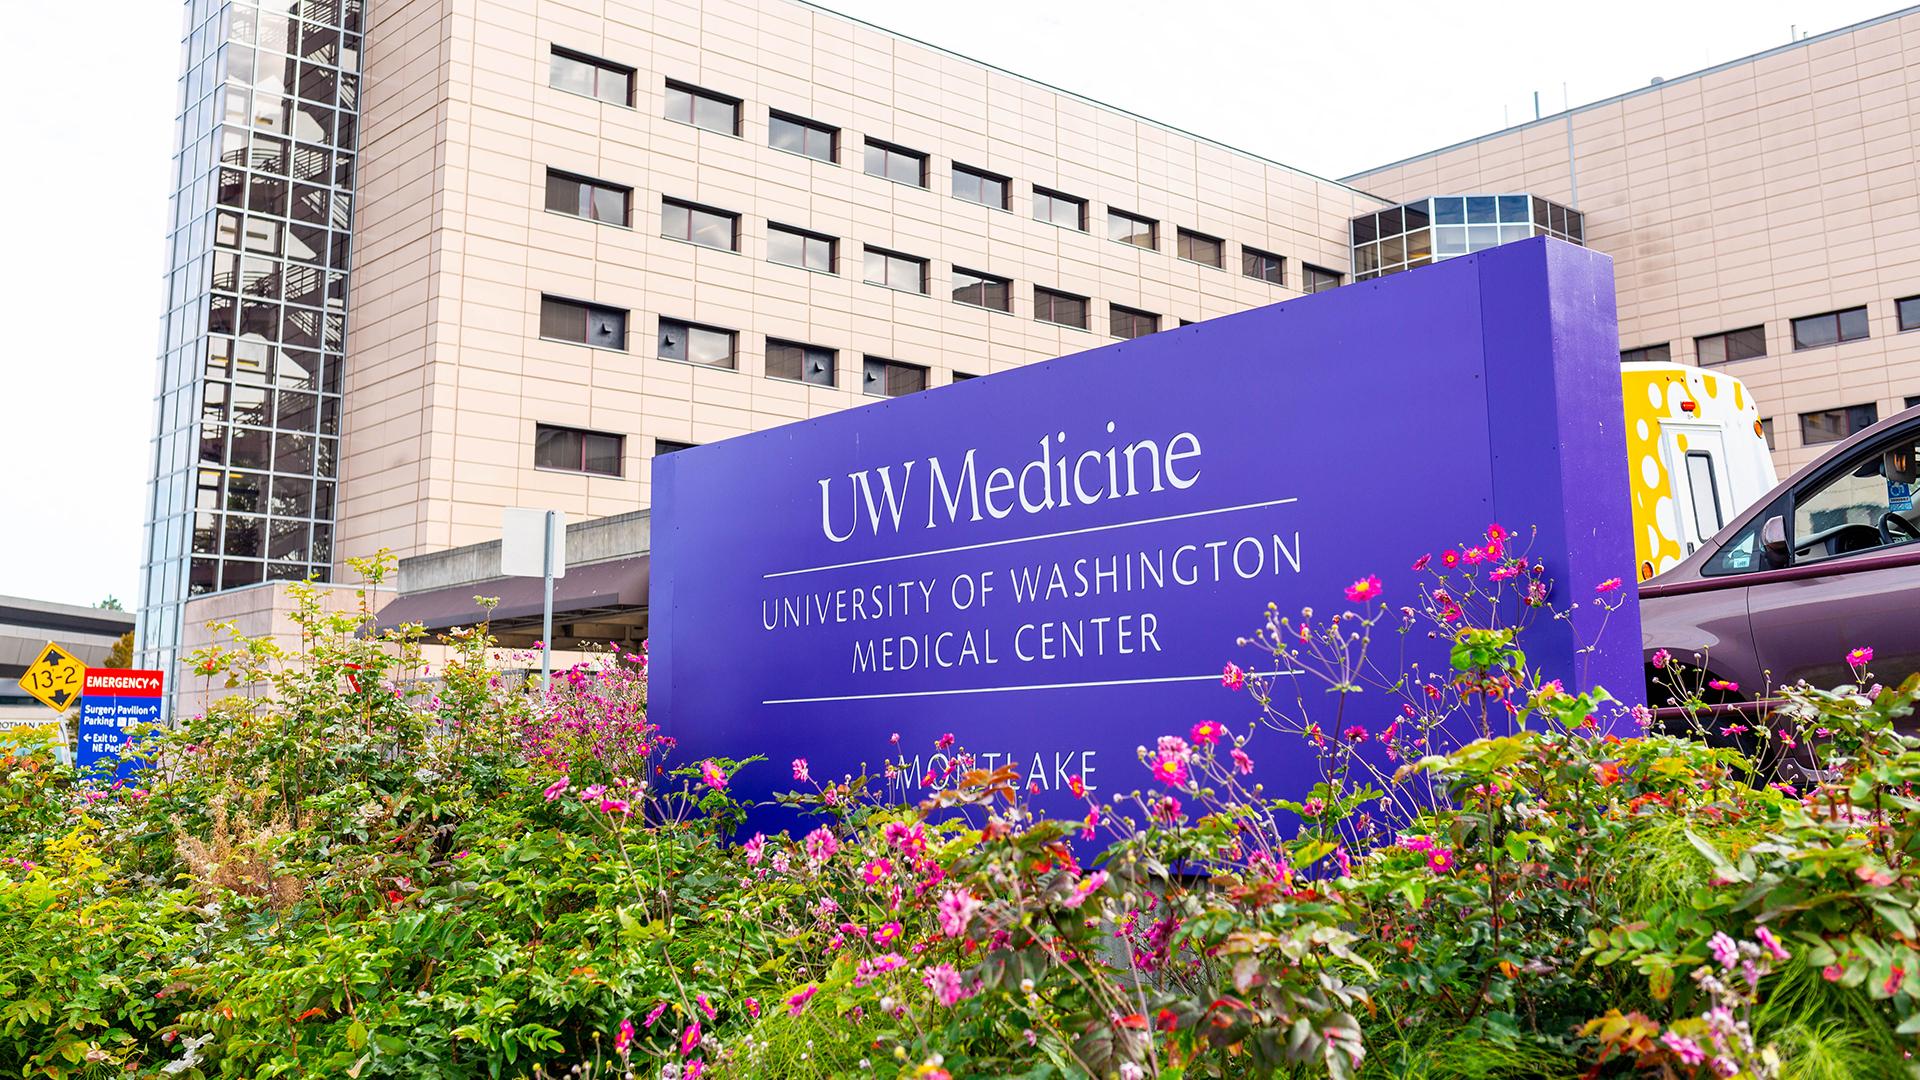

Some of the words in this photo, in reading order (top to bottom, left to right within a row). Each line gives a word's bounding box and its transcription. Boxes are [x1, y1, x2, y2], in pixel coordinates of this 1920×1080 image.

[818, 460, 915, 543] UW
[926, 421, 1202, 528] Medicine
[763, 578, 936, 631] UNIVERSITY
[951, 571, 994, 610] OF
[1010, 531, 1301, 603] WASHINGTON
[852, 628, 999, 674] MEDICAL
[1014, 613, 1162, 662] CENTER
[86, 676, 149, 689] EMERGENCY
[84, 704, 116, 716] Surgery
[117, 705, 149, 715] Pavilion
[83, 716, 114, 727] Parking
[93, 733, 108, 743] Exit
[109, 733, 118, 743] to
[92, 743, 103, 753] NE
